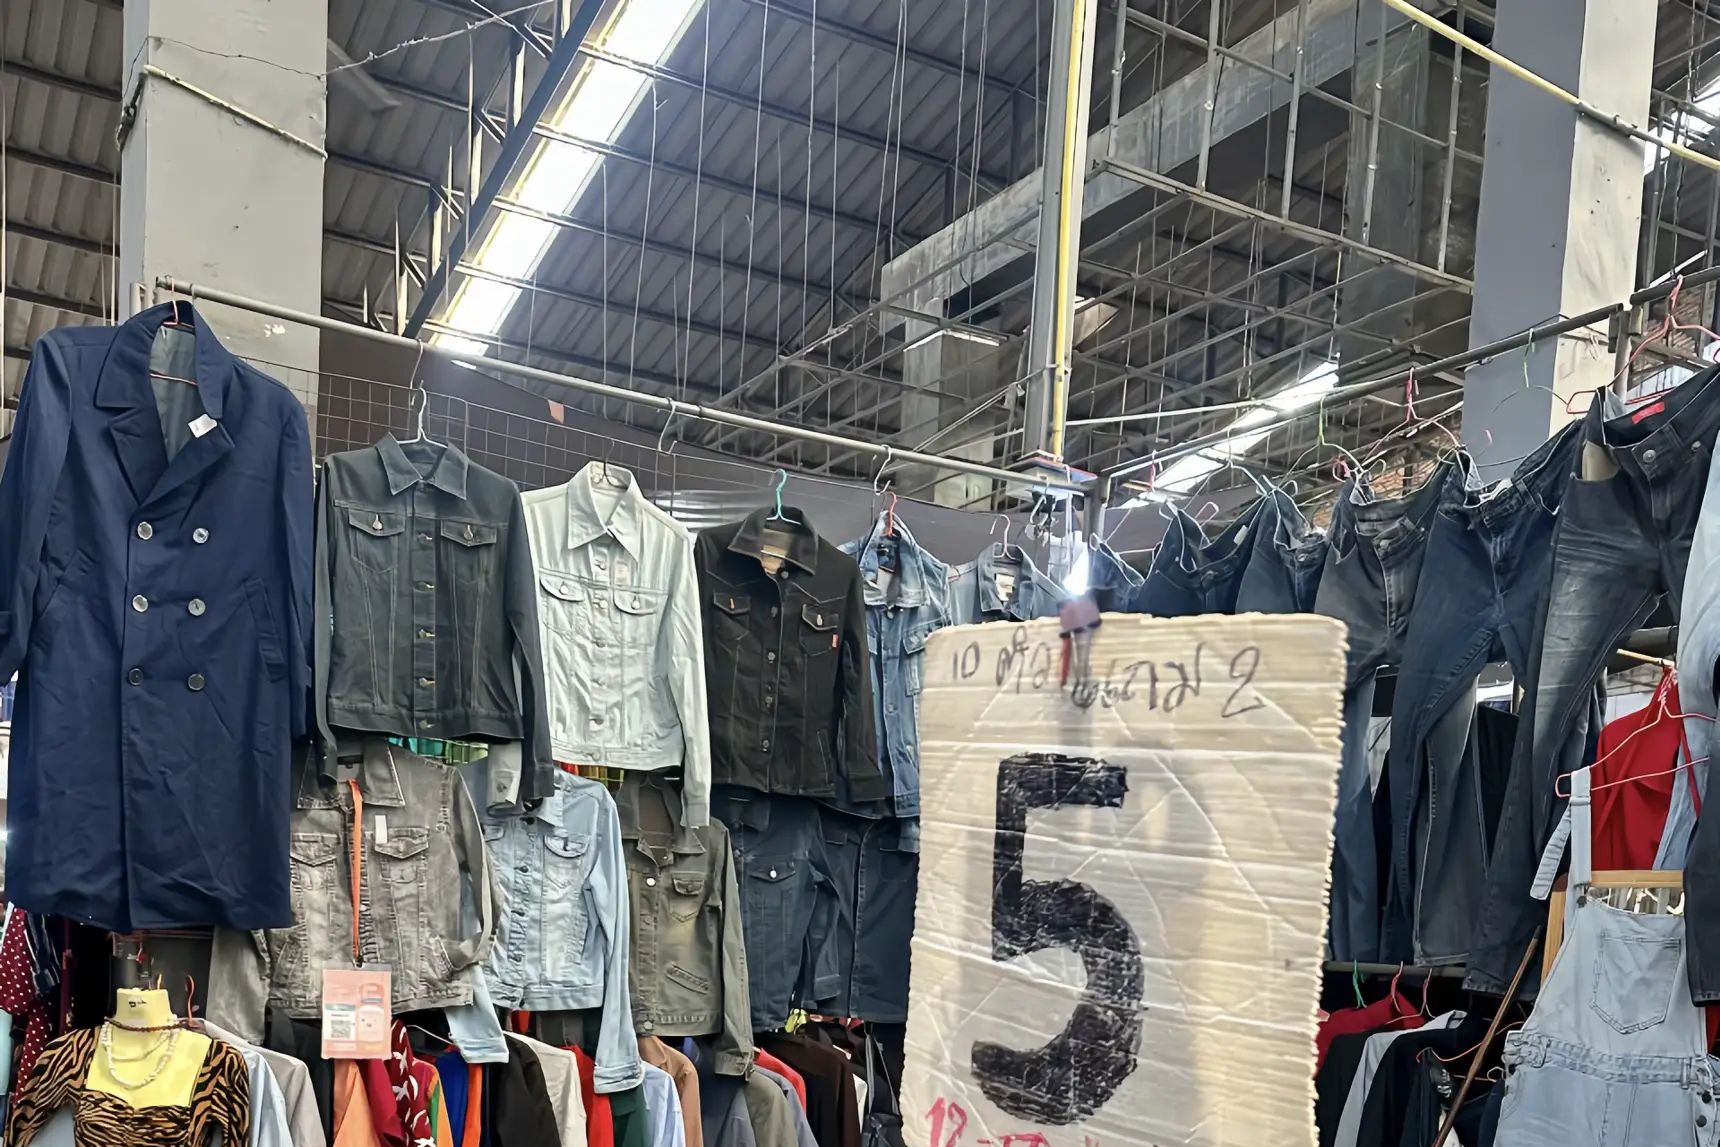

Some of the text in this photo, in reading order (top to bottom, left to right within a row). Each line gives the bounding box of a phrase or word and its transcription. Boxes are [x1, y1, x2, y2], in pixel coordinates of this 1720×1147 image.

[952, 641, 980, 680] 10
[1221, 646, 1268, 718] 2
[971, 752, 1146, 1126] 5
